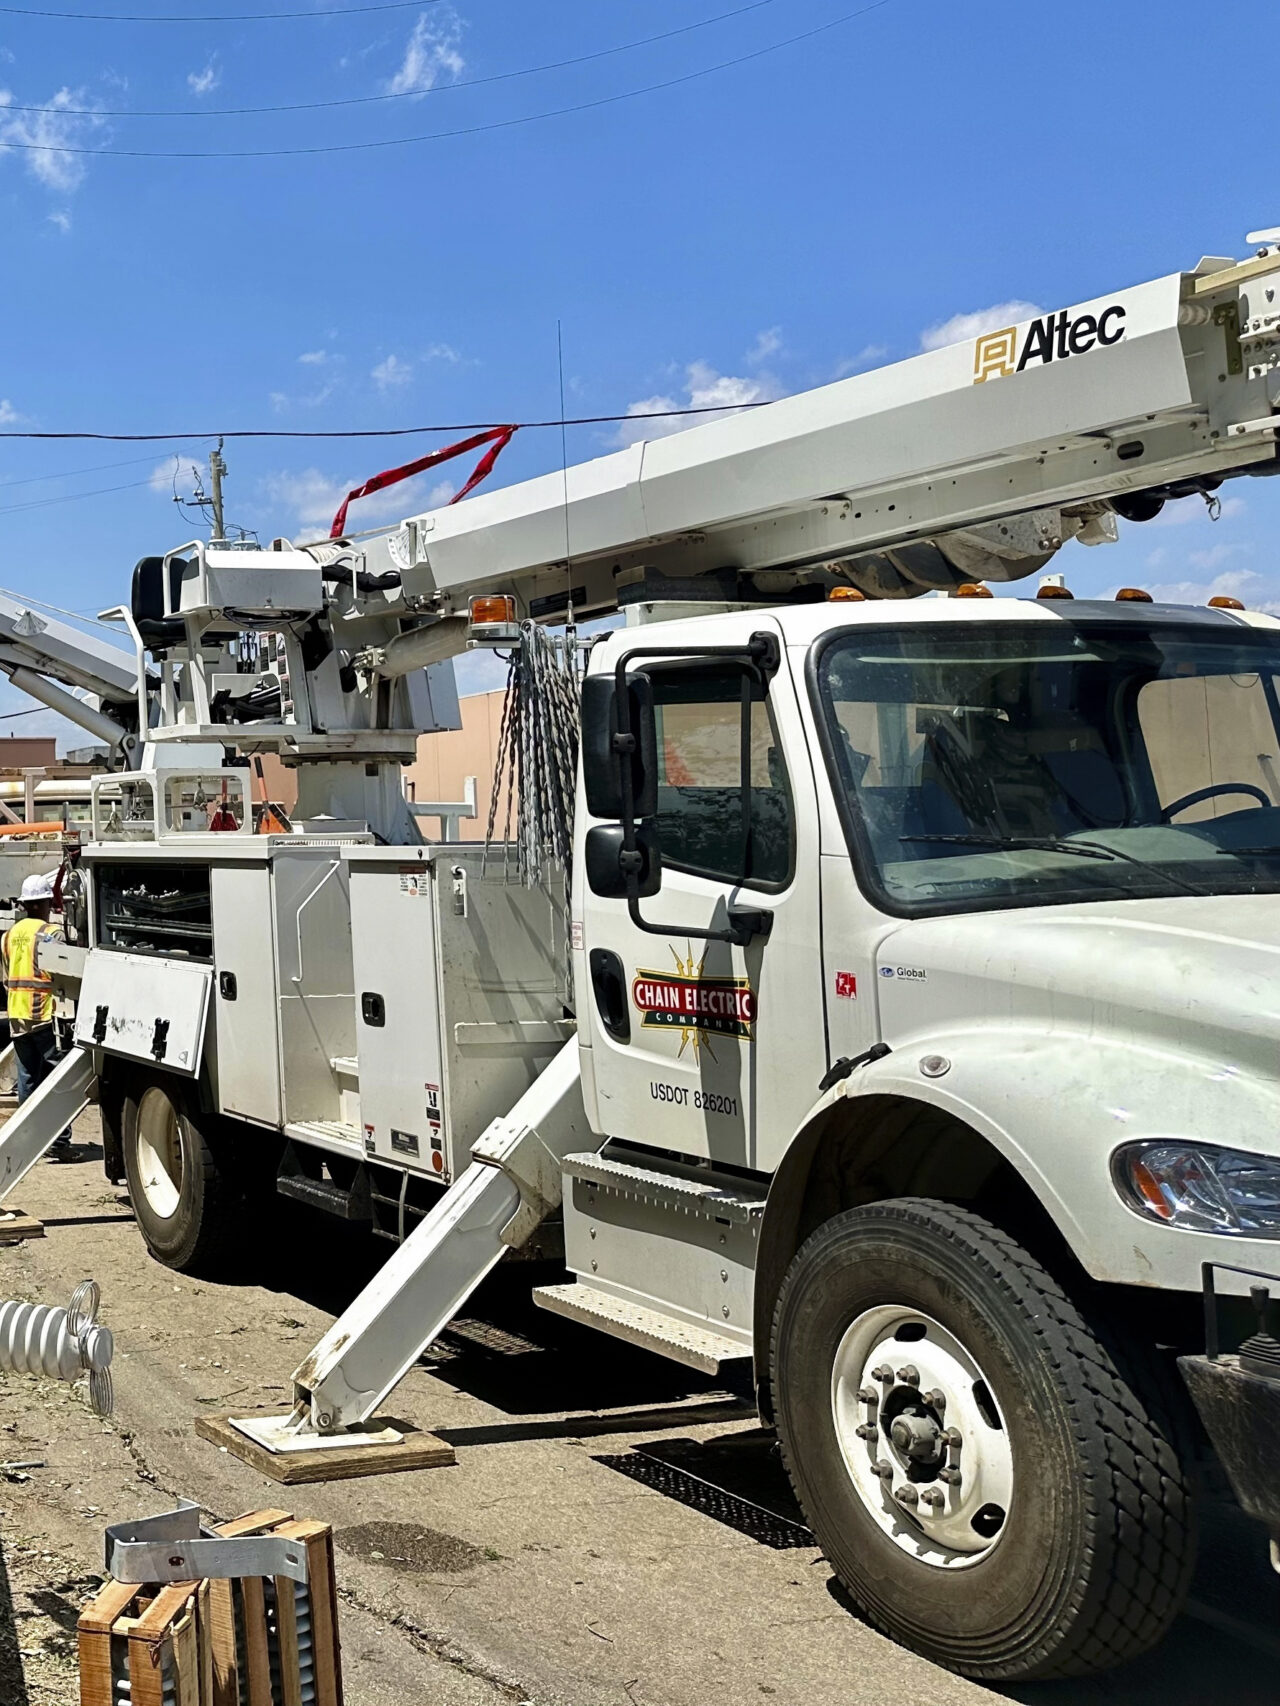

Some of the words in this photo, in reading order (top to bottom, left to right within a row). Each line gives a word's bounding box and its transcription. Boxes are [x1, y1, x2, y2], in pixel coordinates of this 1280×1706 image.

[1016, 305, 1126, 372] Altec
[897, 966, 926, 978] Global
[636, 983, 680, 1009] CHAIN
[684, 988, 751, 1018] ELECTRIC
[656, 1012, 734, 1030] COMPANY
[650, 1082, 689, 1106] USDOT
[694, 1090, 738, 1117] 826201
